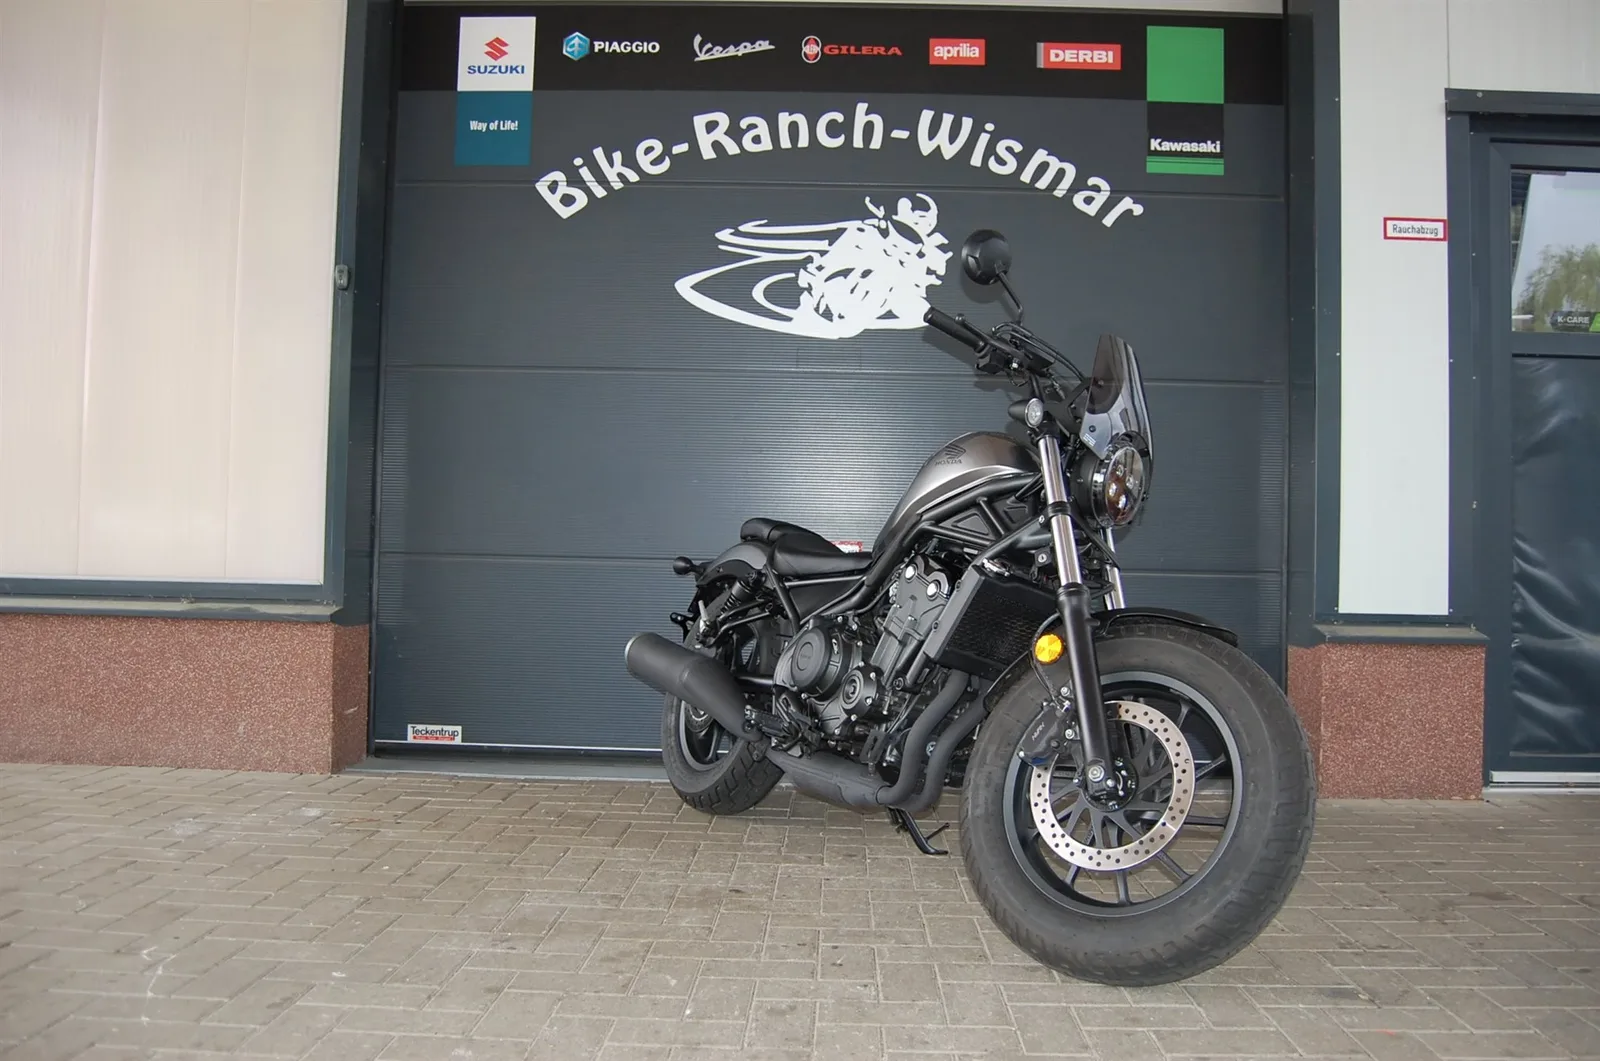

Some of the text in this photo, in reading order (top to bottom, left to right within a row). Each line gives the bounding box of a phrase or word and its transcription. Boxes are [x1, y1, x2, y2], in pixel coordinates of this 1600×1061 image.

[593, 40, 660, 54] PIAGGIO
[693, 33, 776, 62] Vespa
[823, 44, 902, 56] GILERA
[933, 43, 980, 61] aprilia
[1049, 48, 1114, 64] DERBI
[467, 64, 526, 75] SUZUKI
[469, 120, 519, 133] Way of Life!
[1149, 137, 1221, 153] Kawasaki
[534, 102, 1145, 228] Bike-Ranch-Wismar
[1392, 223, 1439, 237] Rauchabzug
[410, 725, 460, 737] Teckentrup
